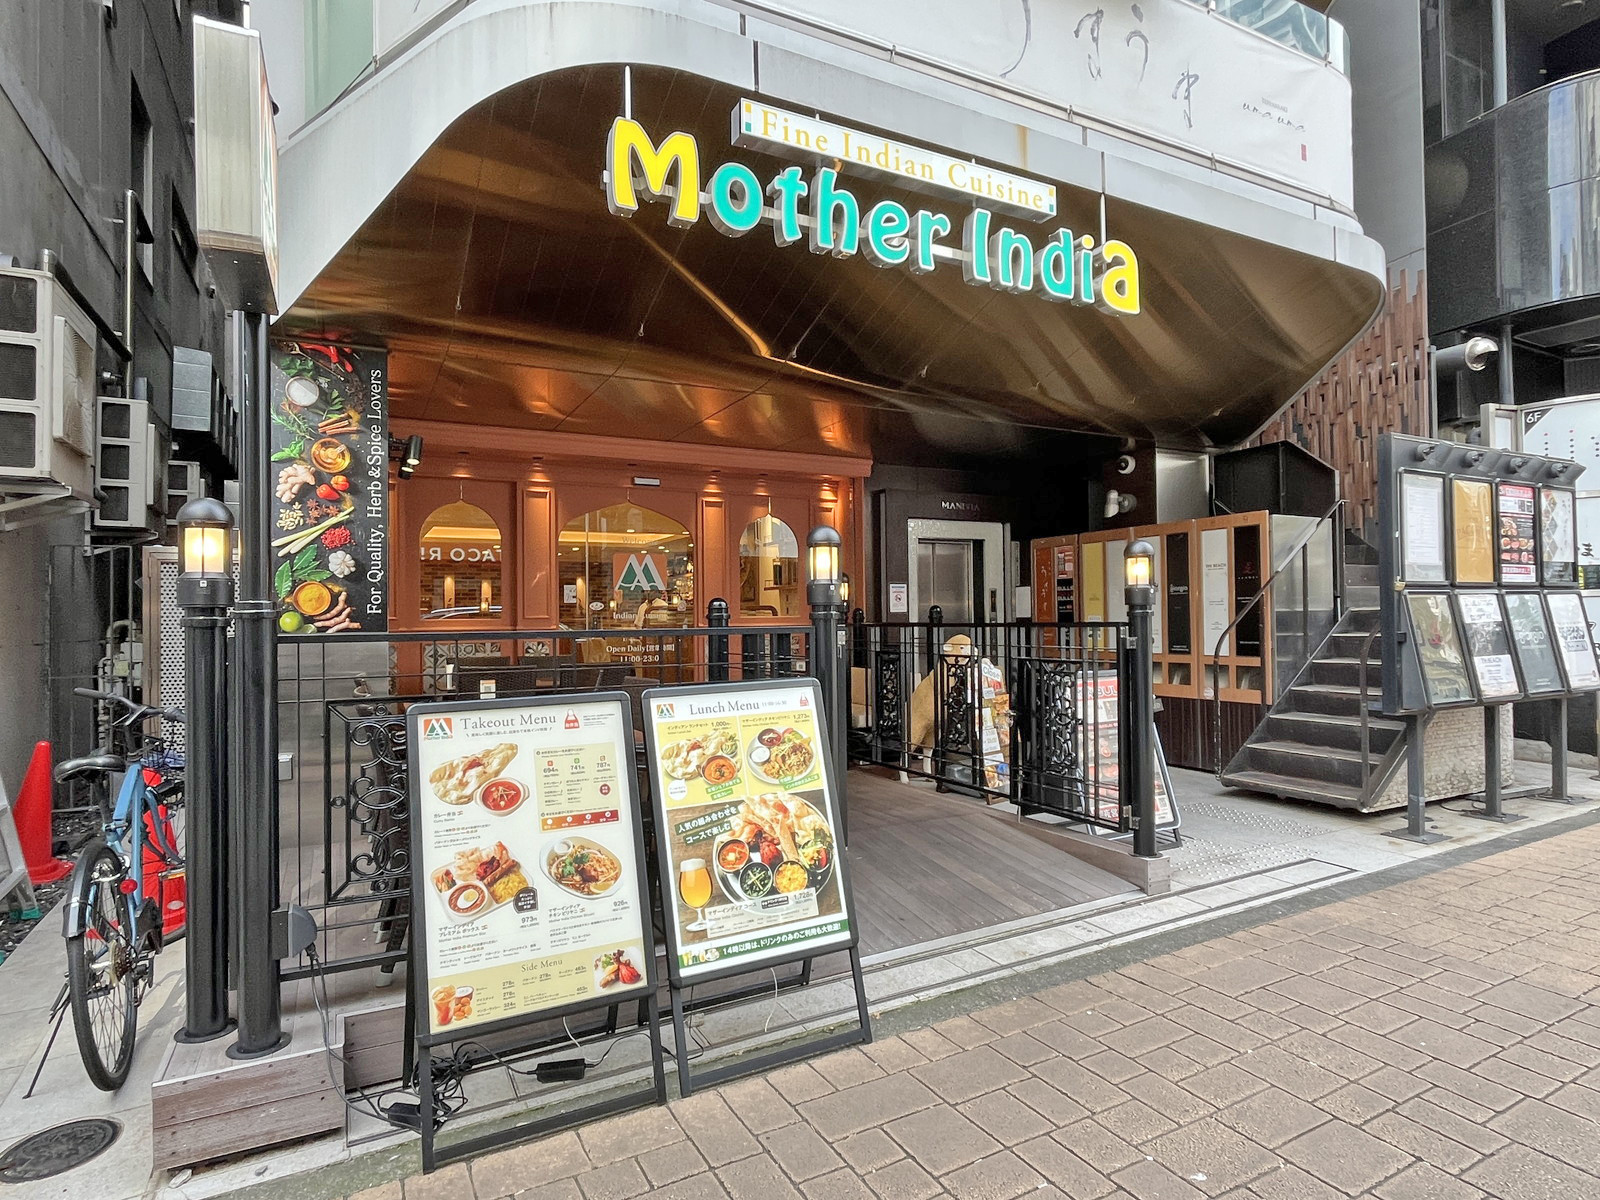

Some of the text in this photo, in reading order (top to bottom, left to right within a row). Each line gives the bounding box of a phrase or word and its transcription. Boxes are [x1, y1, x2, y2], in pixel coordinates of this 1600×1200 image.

[761, 108, 1044, 208] Fine Indian Cuisine
[607, 116, 1141, 315] Mother India
[366, 369, 382, 420] Lovers
[1526, 411, 1542, 424] 6F
[366, 481, 382, 518] Herb
[366, 523, 384, 583] Quality,
[366, 587, 382, 615] For
[606, 645, 626, 653] Open
[627, 644, 645, 653] Daily
[460, 713, 556, 730] Takeout Menu
[689, 701, 725, 716] Lunch
[727, 700, 760, 712] Menu
[678, 806, 738, 834] 人気の組み合わせを
[685, 822, 731, 844] コースで楽しむ
[521, 960, 563, 973] Side Menu
